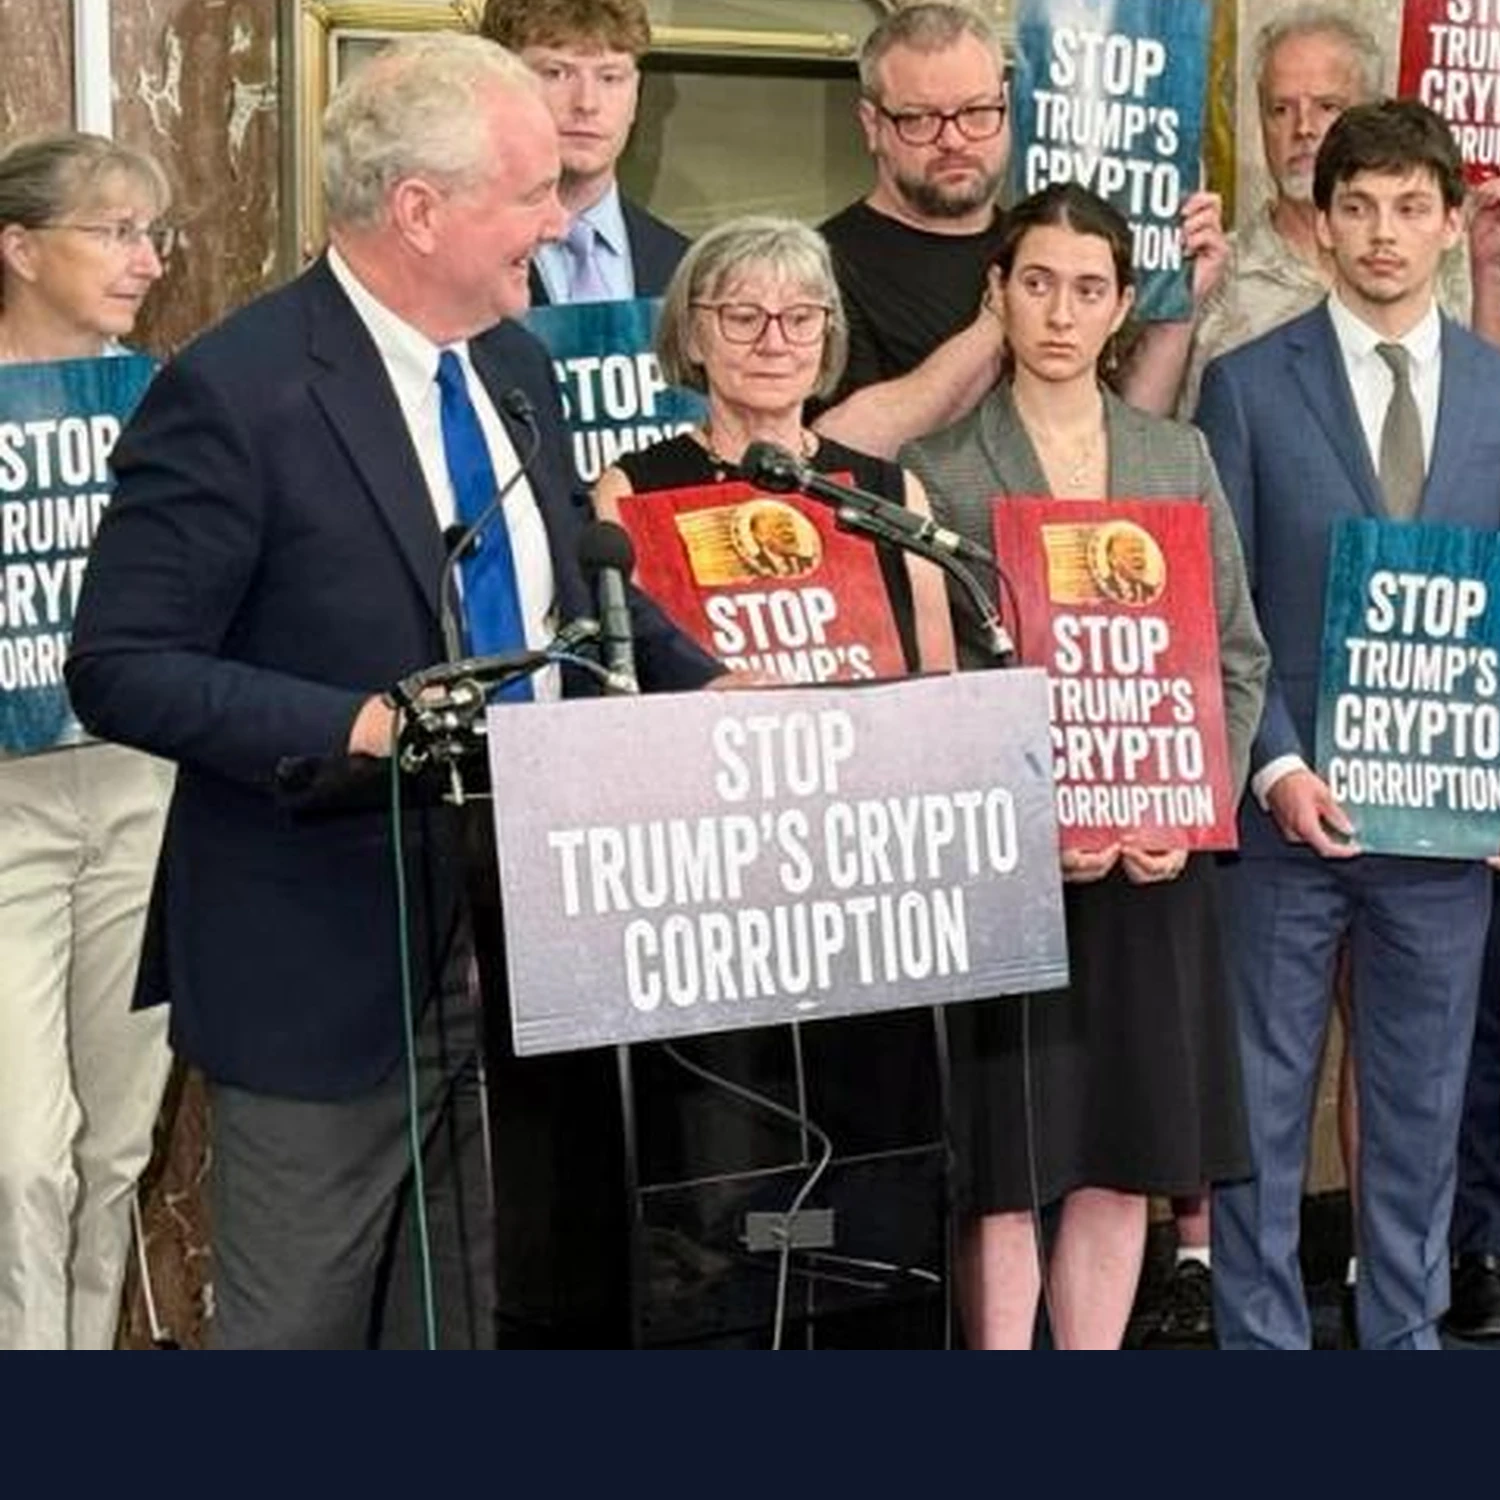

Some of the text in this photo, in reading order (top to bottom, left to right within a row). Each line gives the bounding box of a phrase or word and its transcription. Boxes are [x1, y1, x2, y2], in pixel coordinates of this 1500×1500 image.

[1050, 27, 1166, 98] STOP
[1033, 90, 1180, 155] TRUMP'S
[705, 586, 838, 654] STOP
[1366, 570, 1488, 639] STOP
[1053, 614, 1170, 675] STOP
[1346, 637, 1498, 697] TRUMP'S
[713, 711, 856, 802] STOP
[1334, 693, 1500, 760] CRYPTO
[1057, 784, 1216, 828] ORRUPTION
[549, 787, 1018, 917] TRUMP'S CRYPTO
[624, 887, 970, 1013] CORRUPTION
